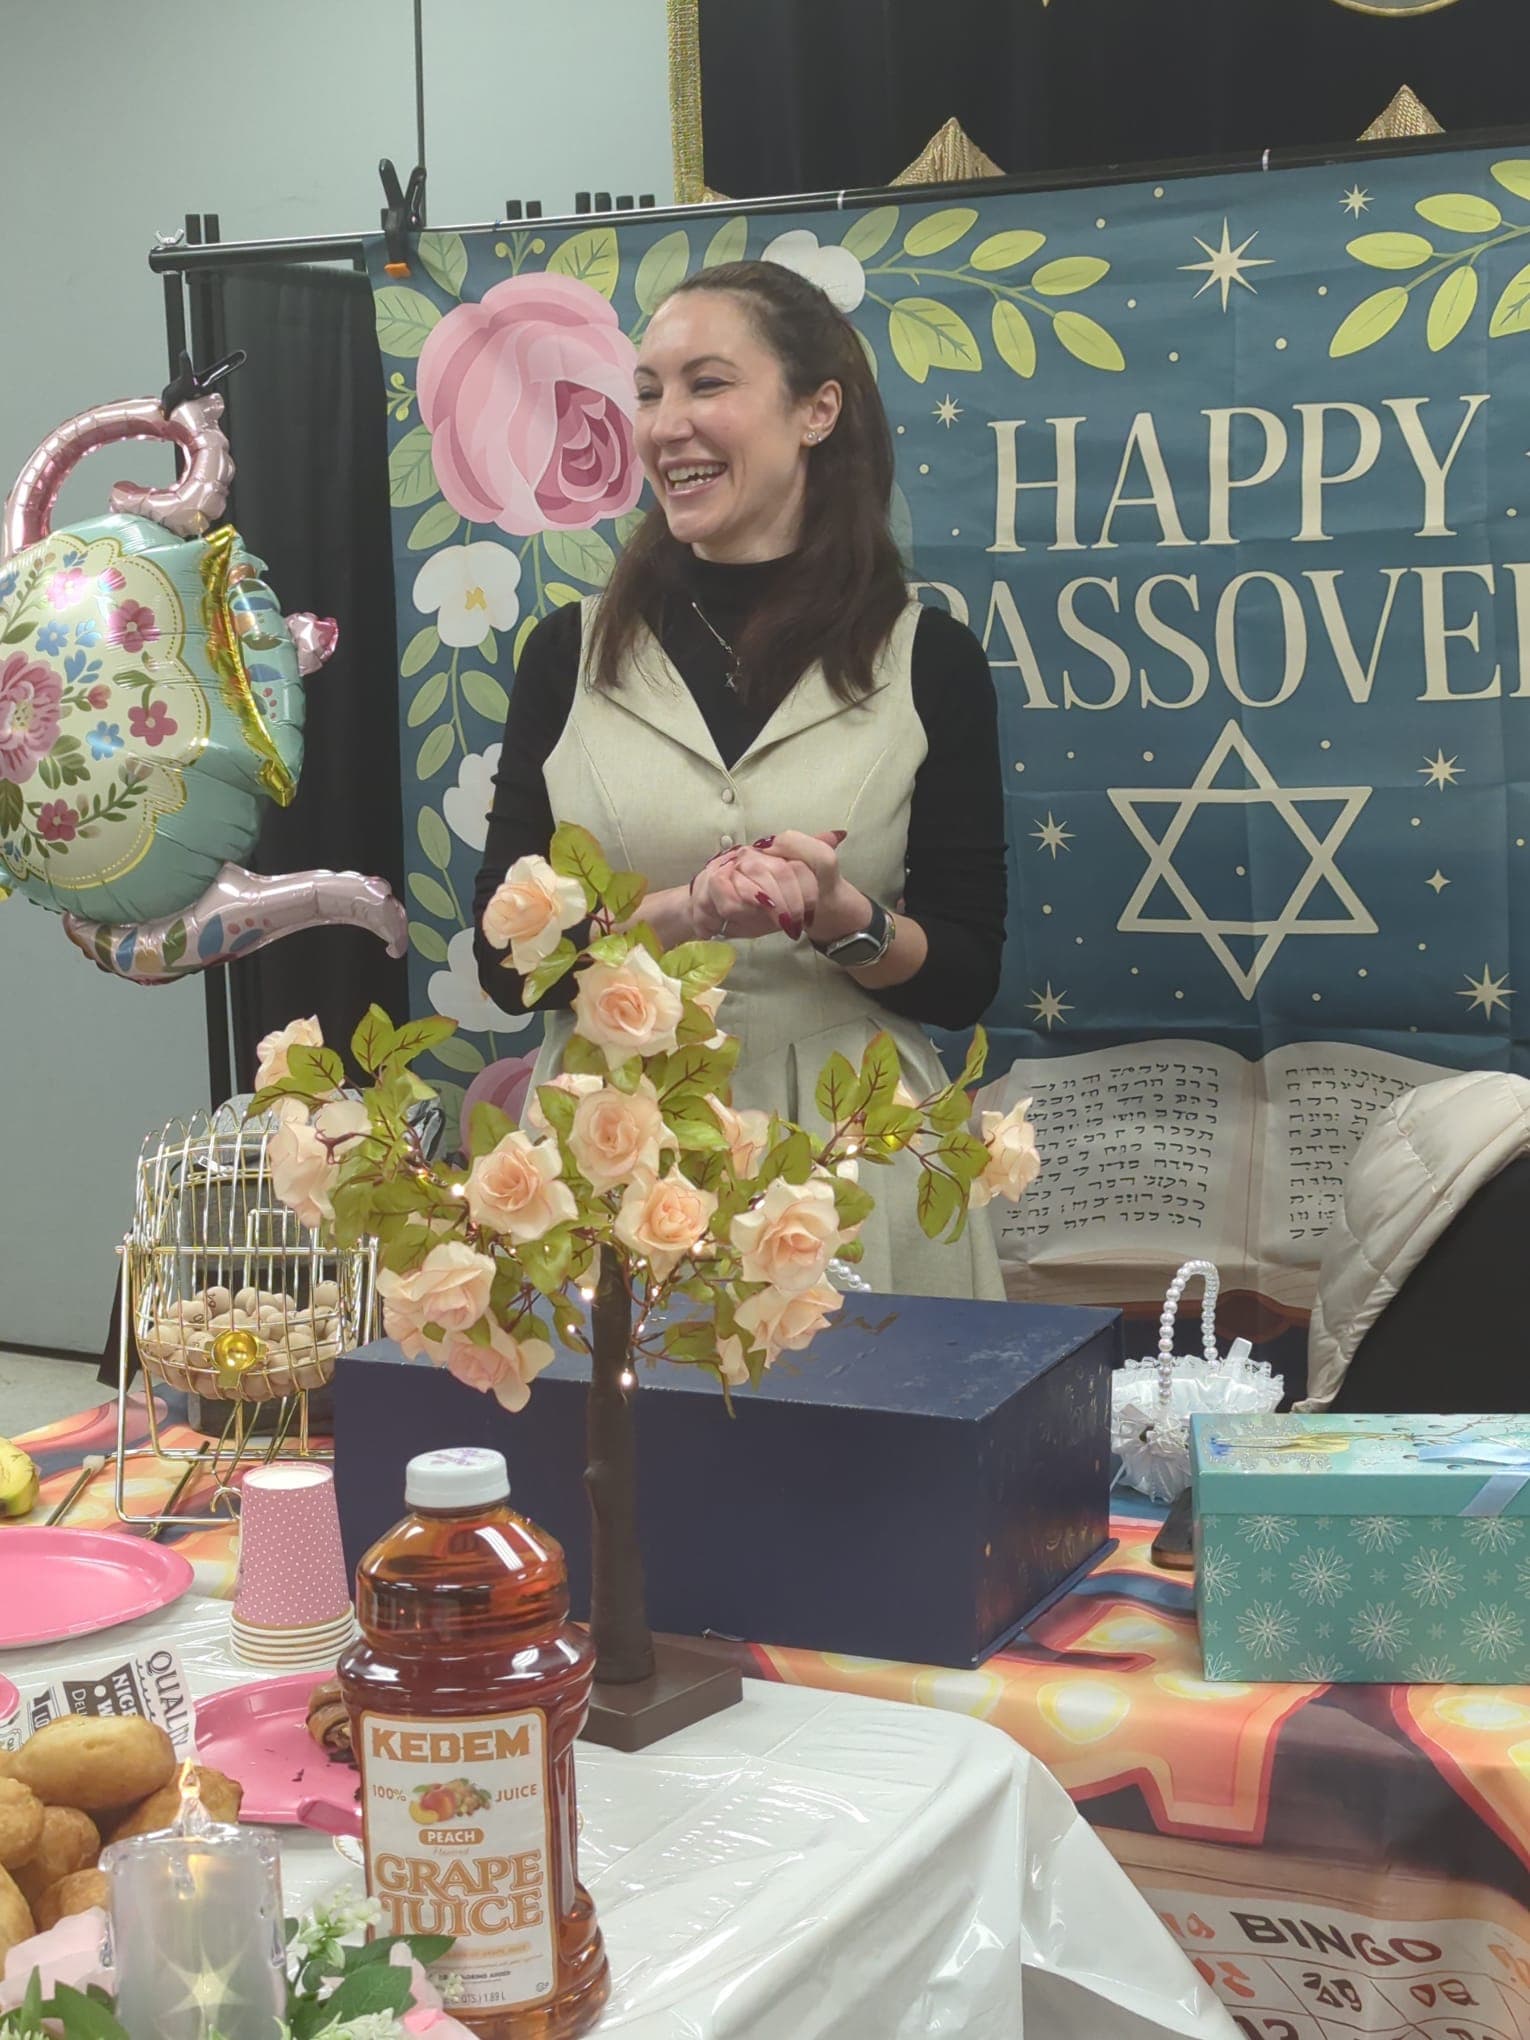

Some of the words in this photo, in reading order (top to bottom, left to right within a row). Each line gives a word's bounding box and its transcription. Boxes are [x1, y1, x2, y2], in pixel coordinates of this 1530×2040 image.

[985, 394, 1490, 552] HAPPY
[371, 1725, 531, 1764] KEDEM
[372, 1783, 407, 1802] 100%
[495, 1783, 538, 1803] JUICE
[427, 1830, 476, 1844] PEACH
[374, 1849, 544, 1904] GRAPE
[379, 1887, 544, 1936] JUICE
[1229, 1911, 1442, 1966] BINGO
